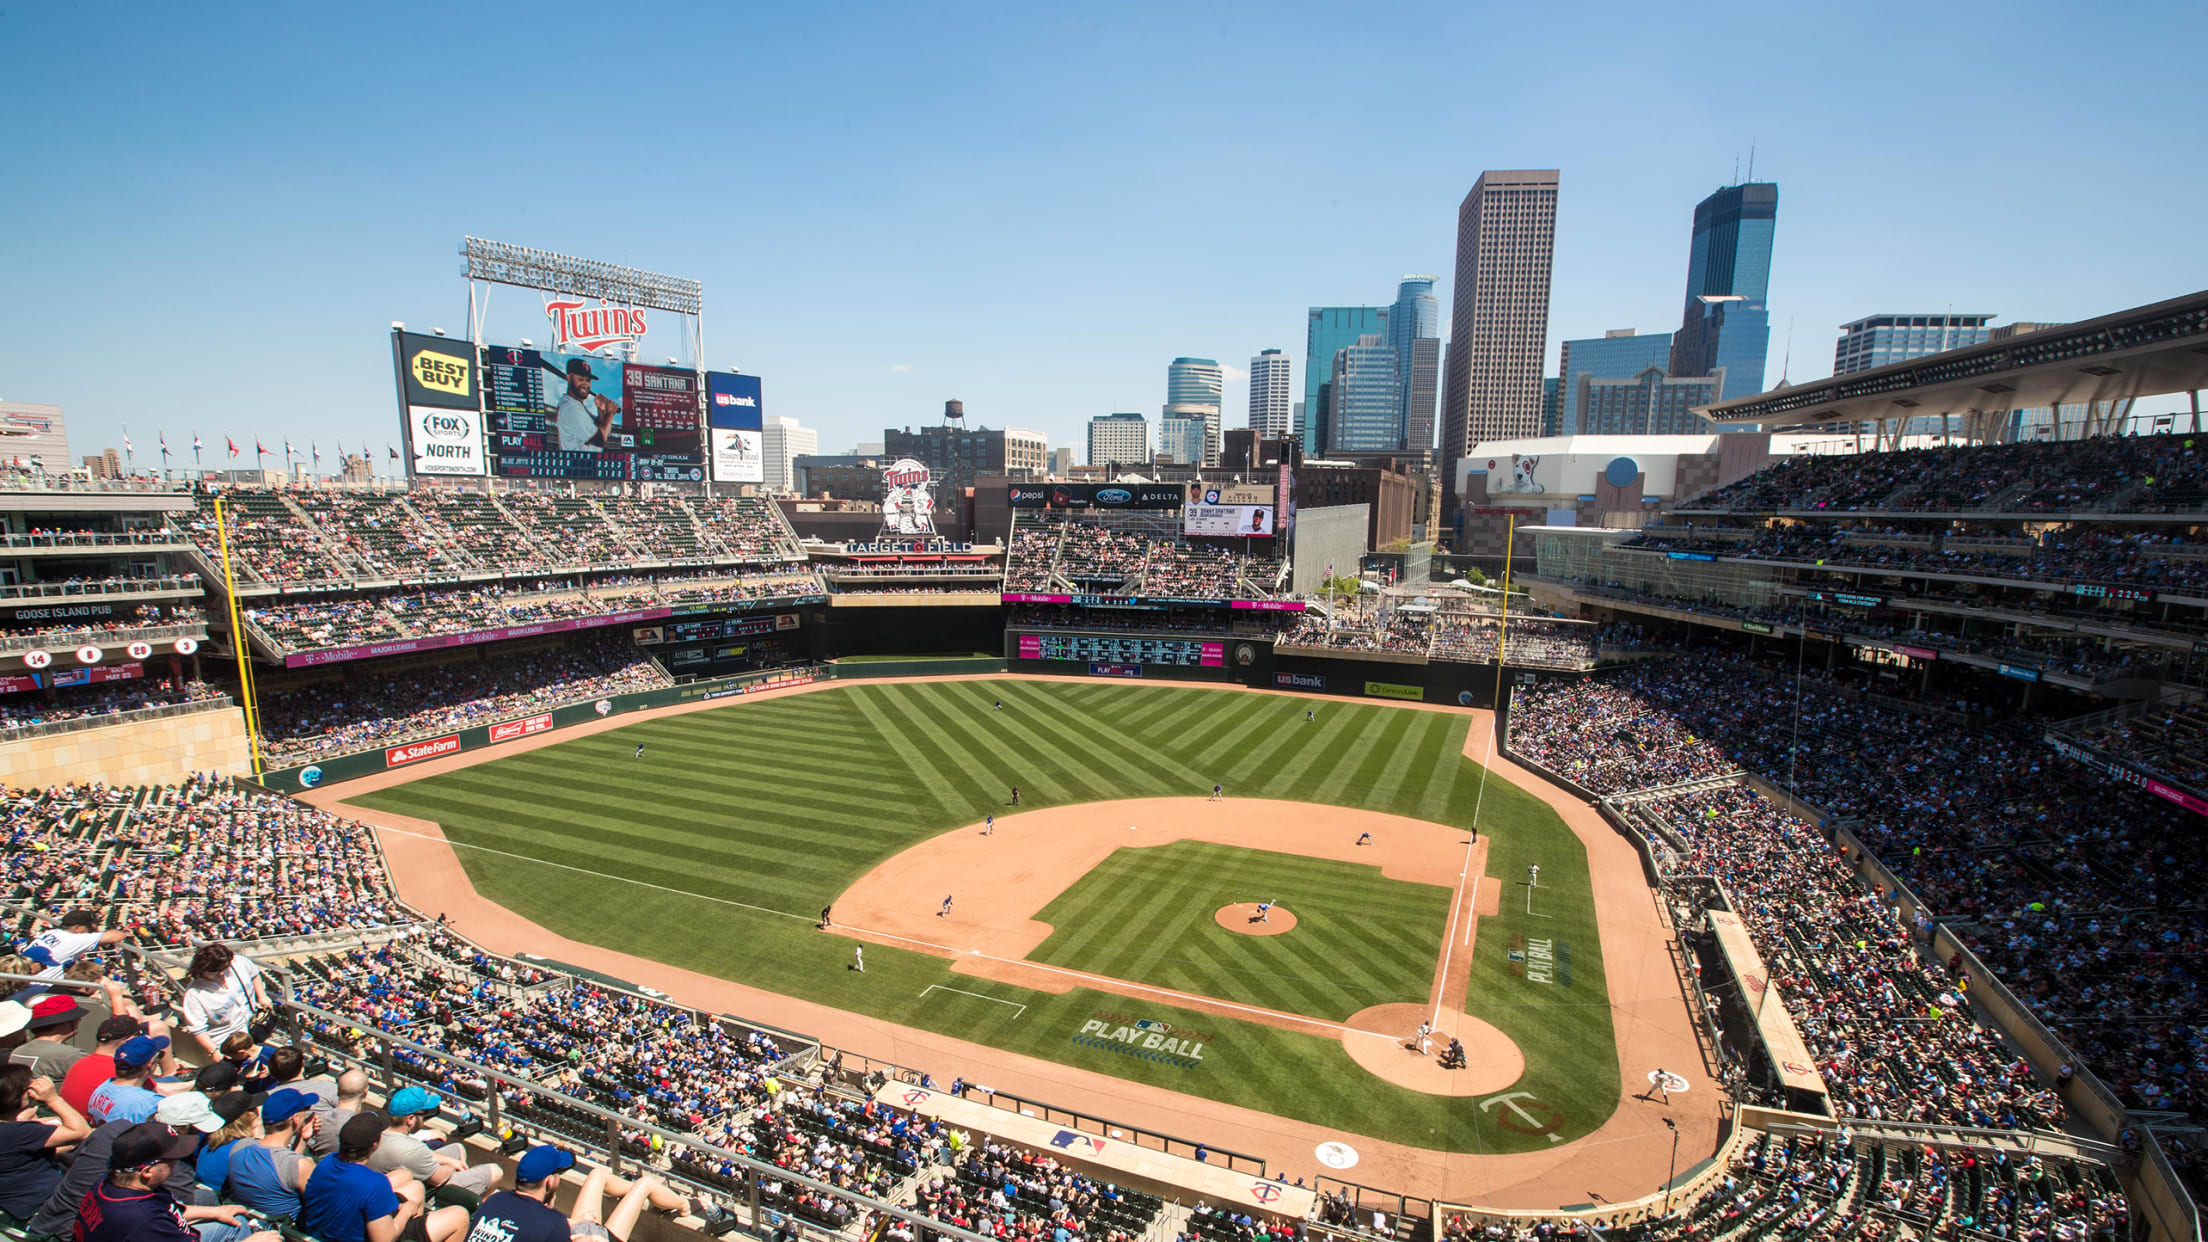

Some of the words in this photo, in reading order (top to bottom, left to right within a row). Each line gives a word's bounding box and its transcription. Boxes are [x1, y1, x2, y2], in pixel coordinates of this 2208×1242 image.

[547, 298, 648, 346] Twins
[420, 357, 467, 378] BEST
[422, 370, 463, 388] BUY
[626, 370, 642, 386] 39
[644, 375, 687, 391] SANTANA
[432, 417, 460, 431] FOX
[433, 429, 462, 437] SPORTS
[502, 436, 522, 446] PLAY
[522, 437, 543, 447] BALL
[426, 443, 471, 459] NORTH
[884, 468, 929, 489] Twins
[1022, 490, 1044, 501] pepsi
[1103, 490, 1124, 501] Ford
[1189, 508, 1198, 517] 39
[849, 543, 910, 553] TARGET
[927, 542, 973, 552] FIELD
[15, 608, 51, 620] GOOSE
[52, 606, 90, 618] ISLAND
[91, 605, 112, 615] PUB
[184, 642, 190, 650] 3
[371, 645, 393, 655] MAJOR
[393, 642, 418, 651] LEAGUE
[32, 654, 45, 665] 14
[1528, 938, 1552, 960] BALL
[1528, 958, 1553, 984] PLAY
[1080, 1019, 1146, 1044] PLAY
[1142, 1033, 1204, 1060] BALL
